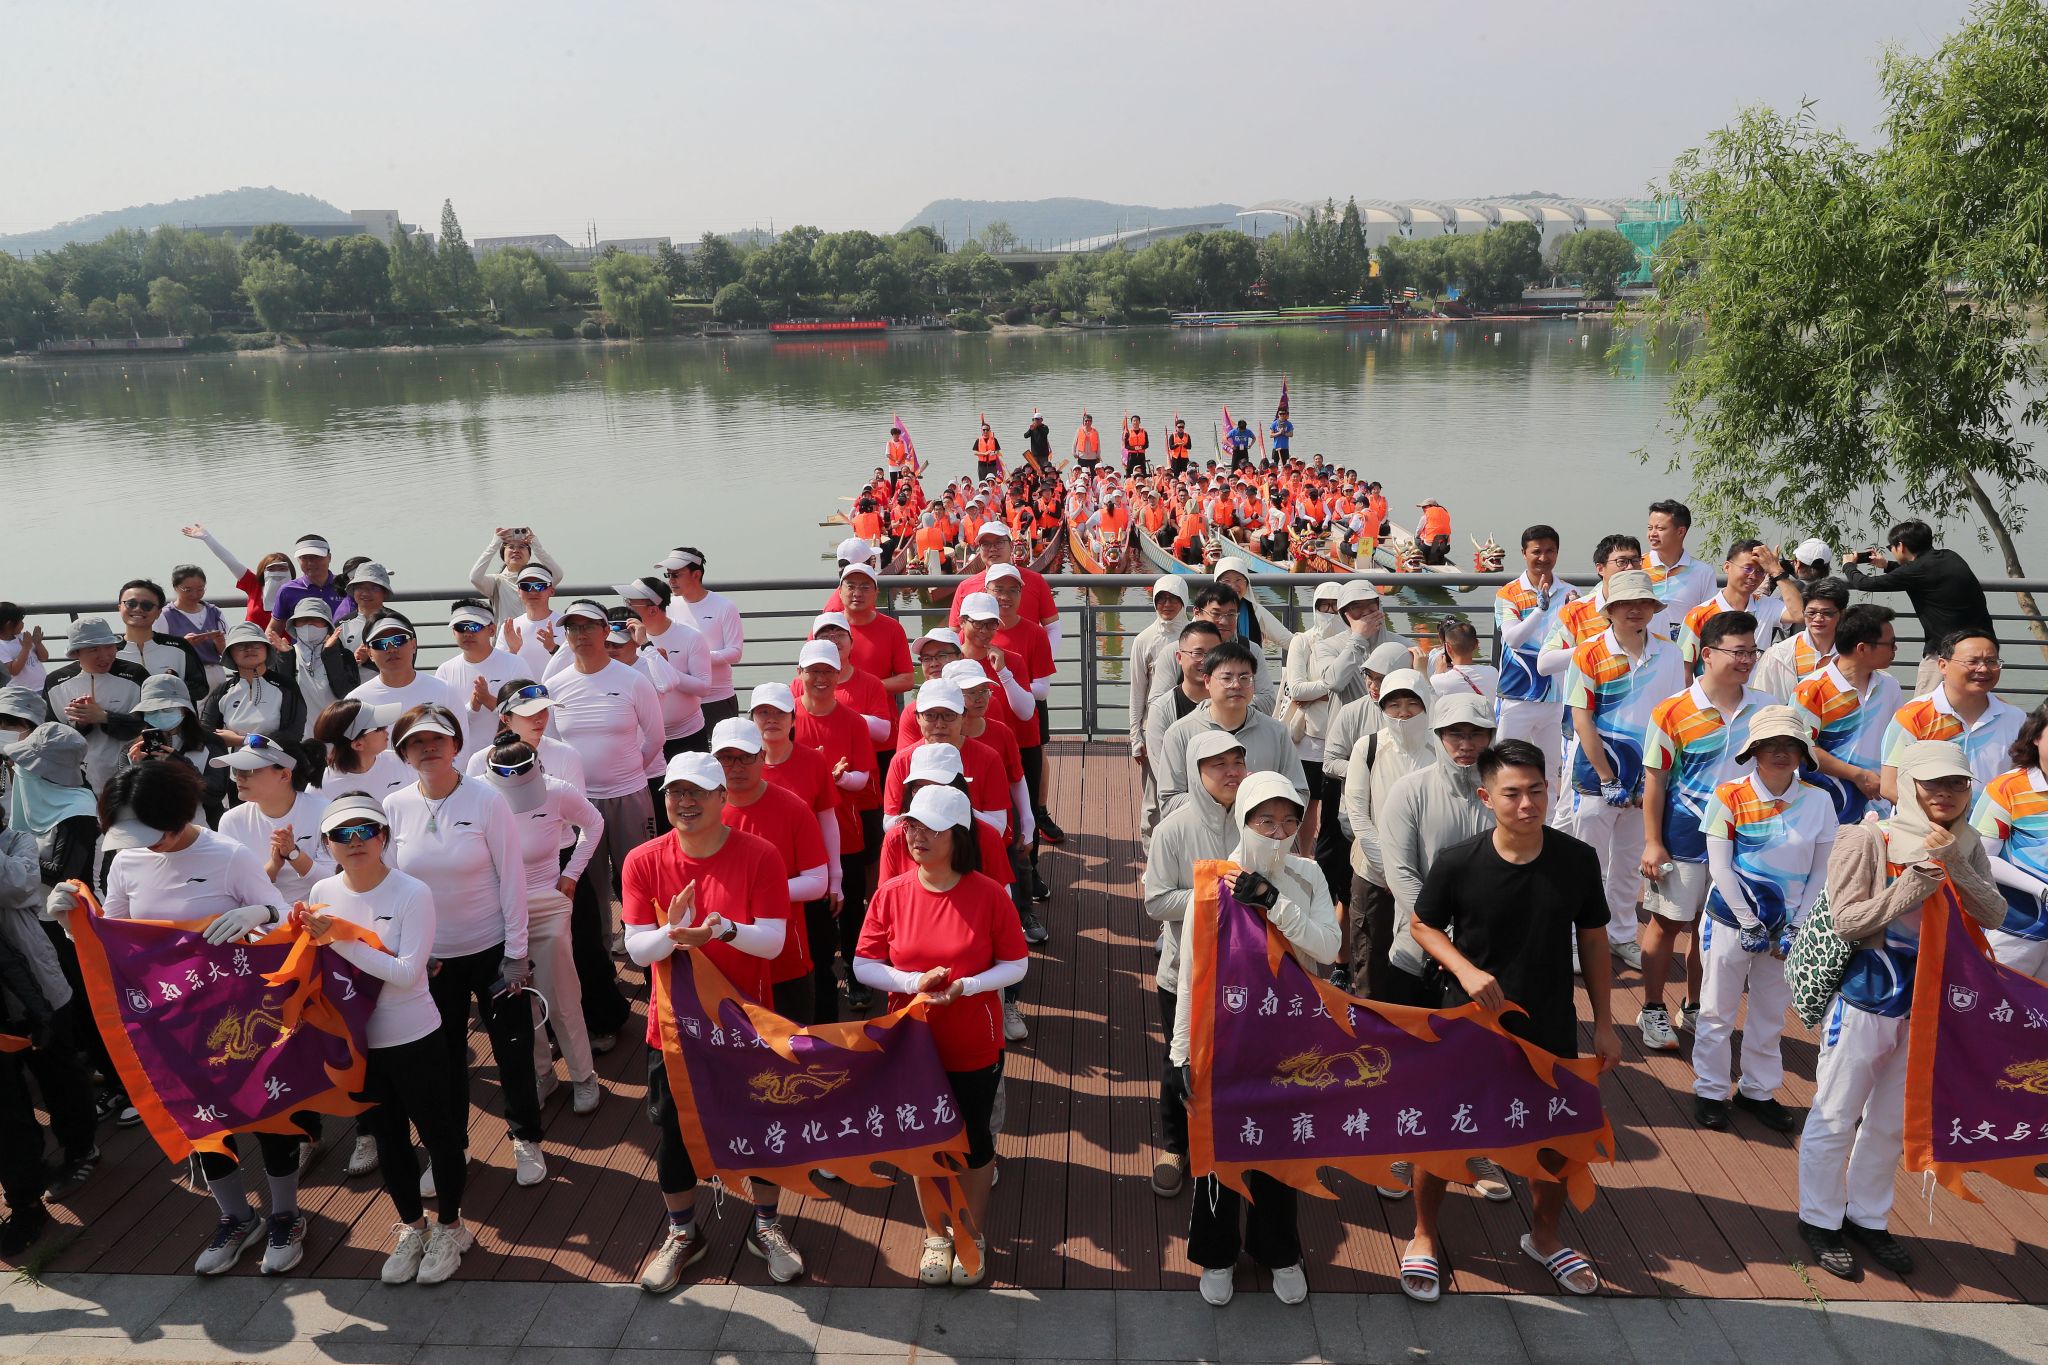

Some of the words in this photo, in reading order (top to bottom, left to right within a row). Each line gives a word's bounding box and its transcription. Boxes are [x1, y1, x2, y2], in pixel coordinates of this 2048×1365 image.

[710, 1021, 795, 1051] 南京大
[728, 1094, 956, 1156] 化学化工学院龙
